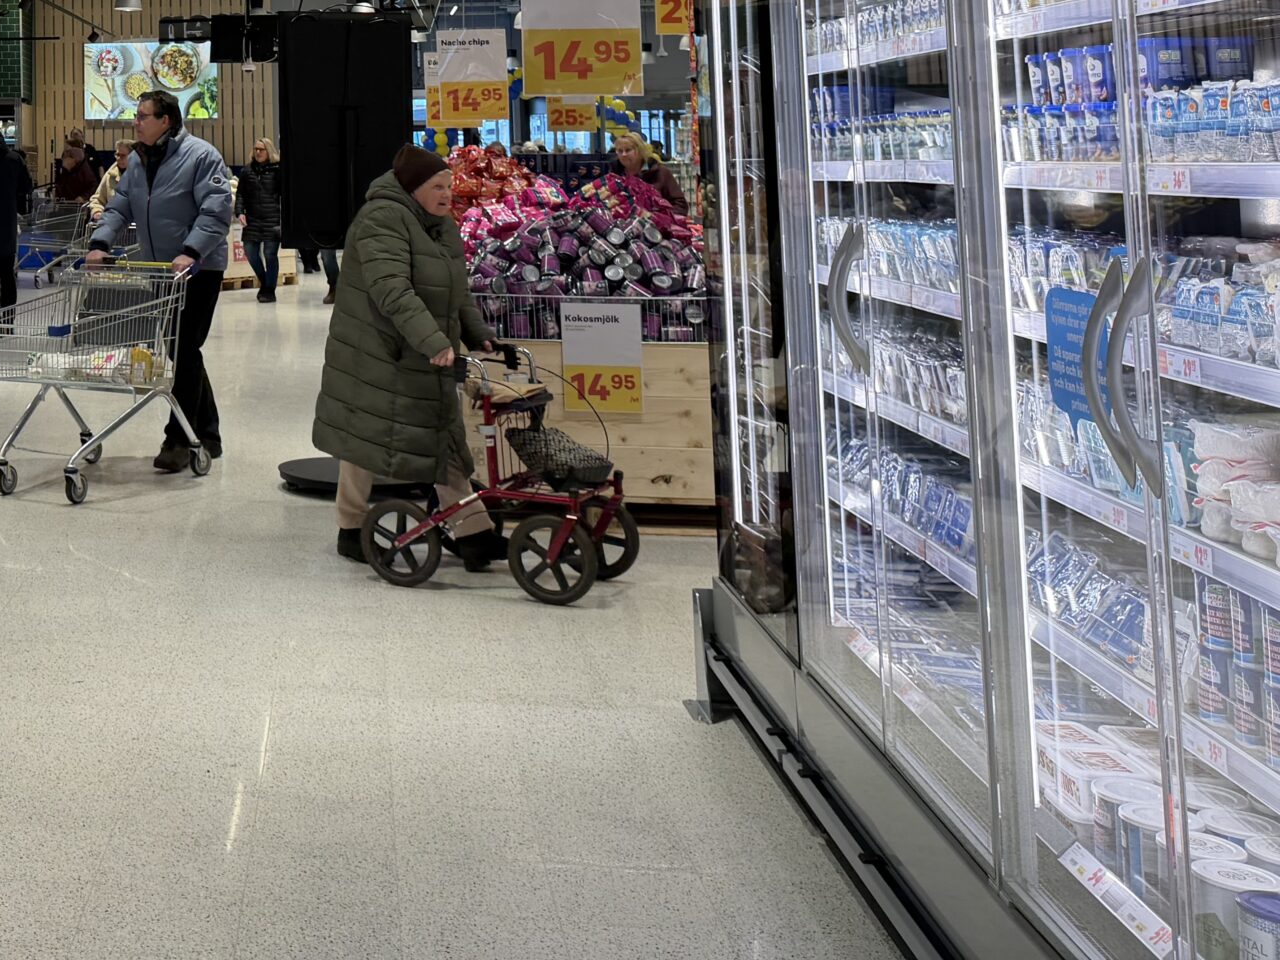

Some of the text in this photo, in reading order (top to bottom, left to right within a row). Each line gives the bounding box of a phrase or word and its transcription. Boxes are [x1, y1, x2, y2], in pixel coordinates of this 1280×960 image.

[440, 38, 490, 47] Nacho chips
[550, 108, 593, 126] 25:-
[564, 314, 620, 325] Kokosmjölk
